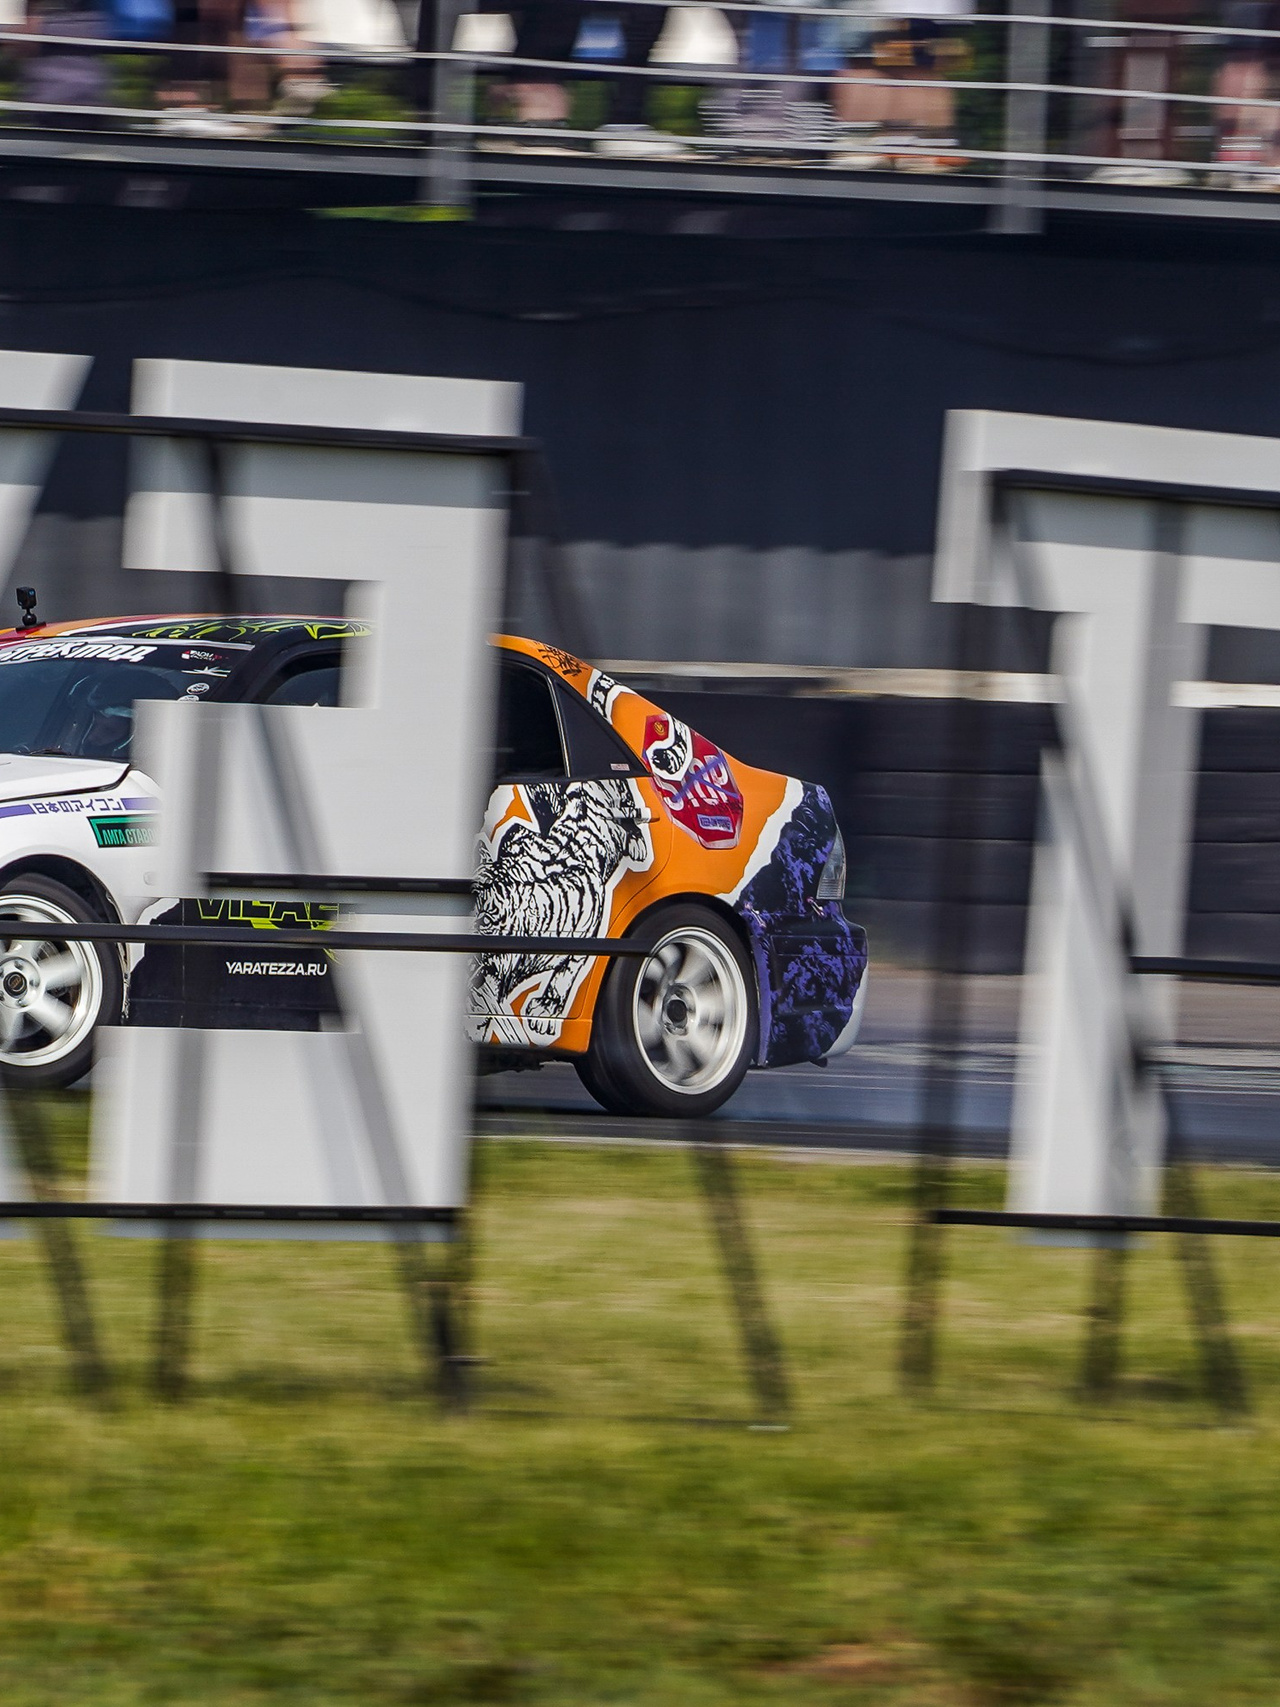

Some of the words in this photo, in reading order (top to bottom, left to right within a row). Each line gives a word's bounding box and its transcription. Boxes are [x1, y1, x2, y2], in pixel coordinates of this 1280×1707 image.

[656, 754, 729, 811] STOP
[33, 798, 123, 814] 日本のアイコン
[101, 828, 126, 845] ЛИГА
[124, 828, 161, 844] СТАВО
[225, 961, 328, 977] YARATEZZA.RU
